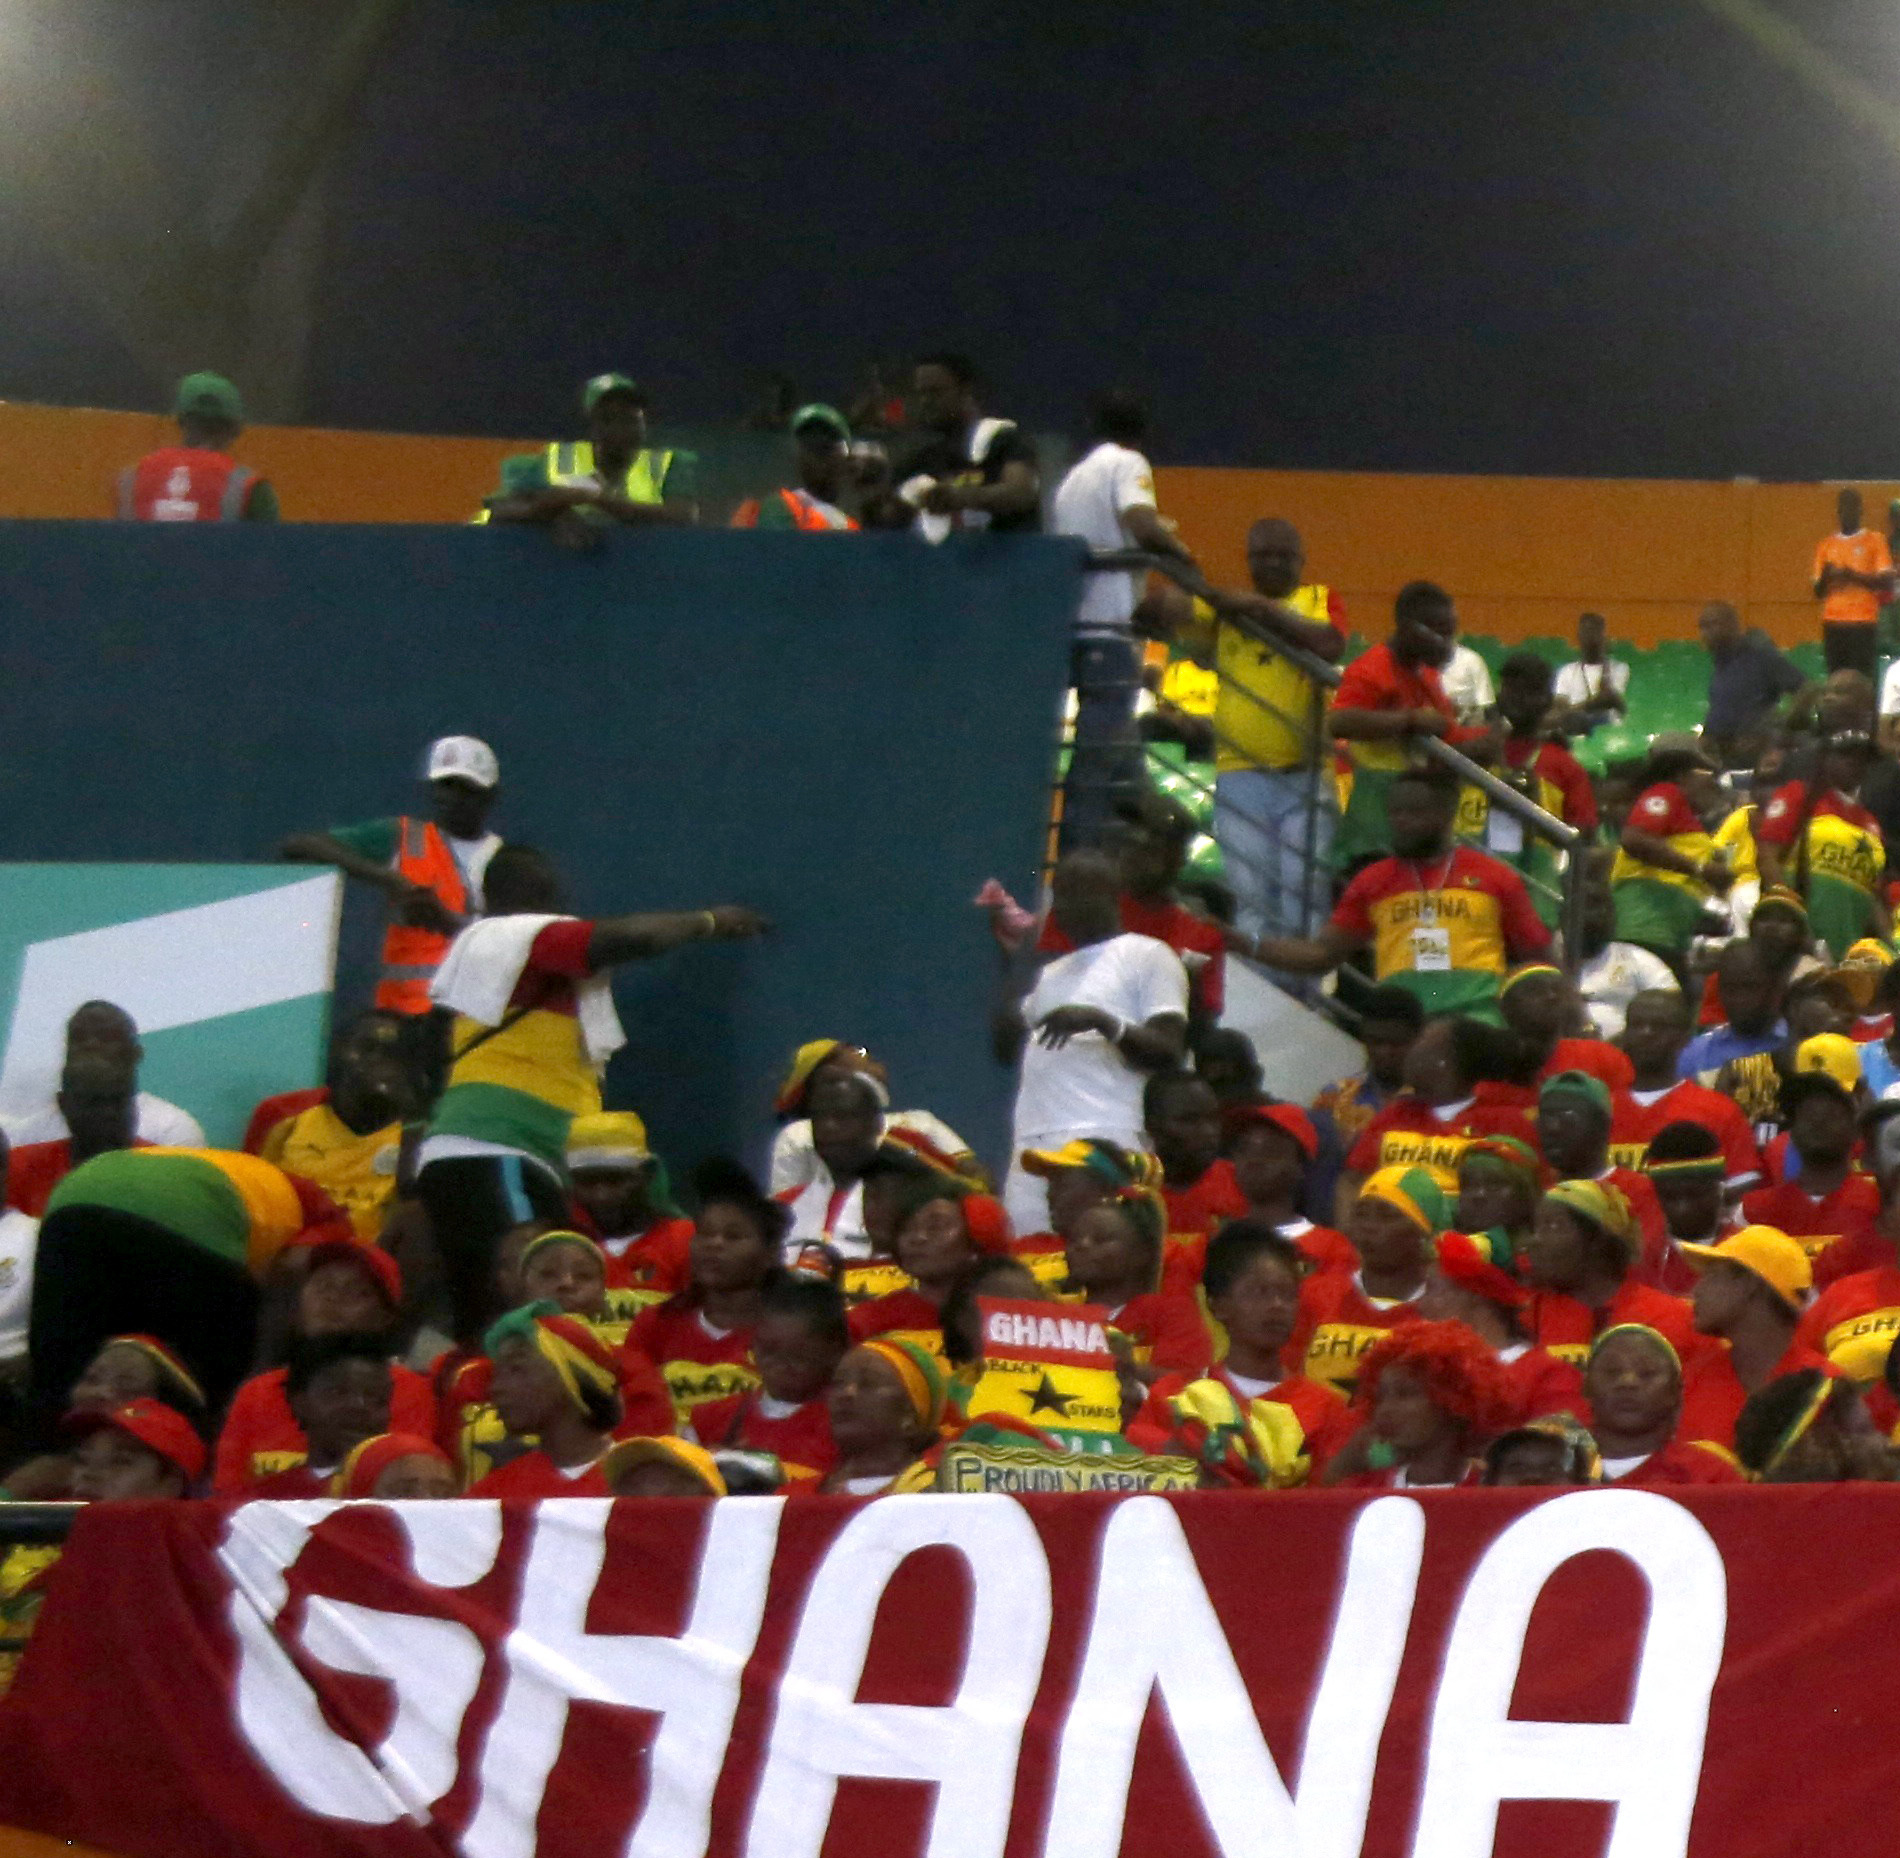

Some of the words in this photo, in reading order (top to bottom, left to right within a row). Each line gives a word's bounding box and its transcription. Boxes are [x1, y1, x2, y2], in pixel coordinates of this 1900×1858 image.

[989, 1312, 1110, 1355] GHANA
[990, 1359, 1042, 1377] BLACK
[1067, 1401, 1116, 1418] STARS
